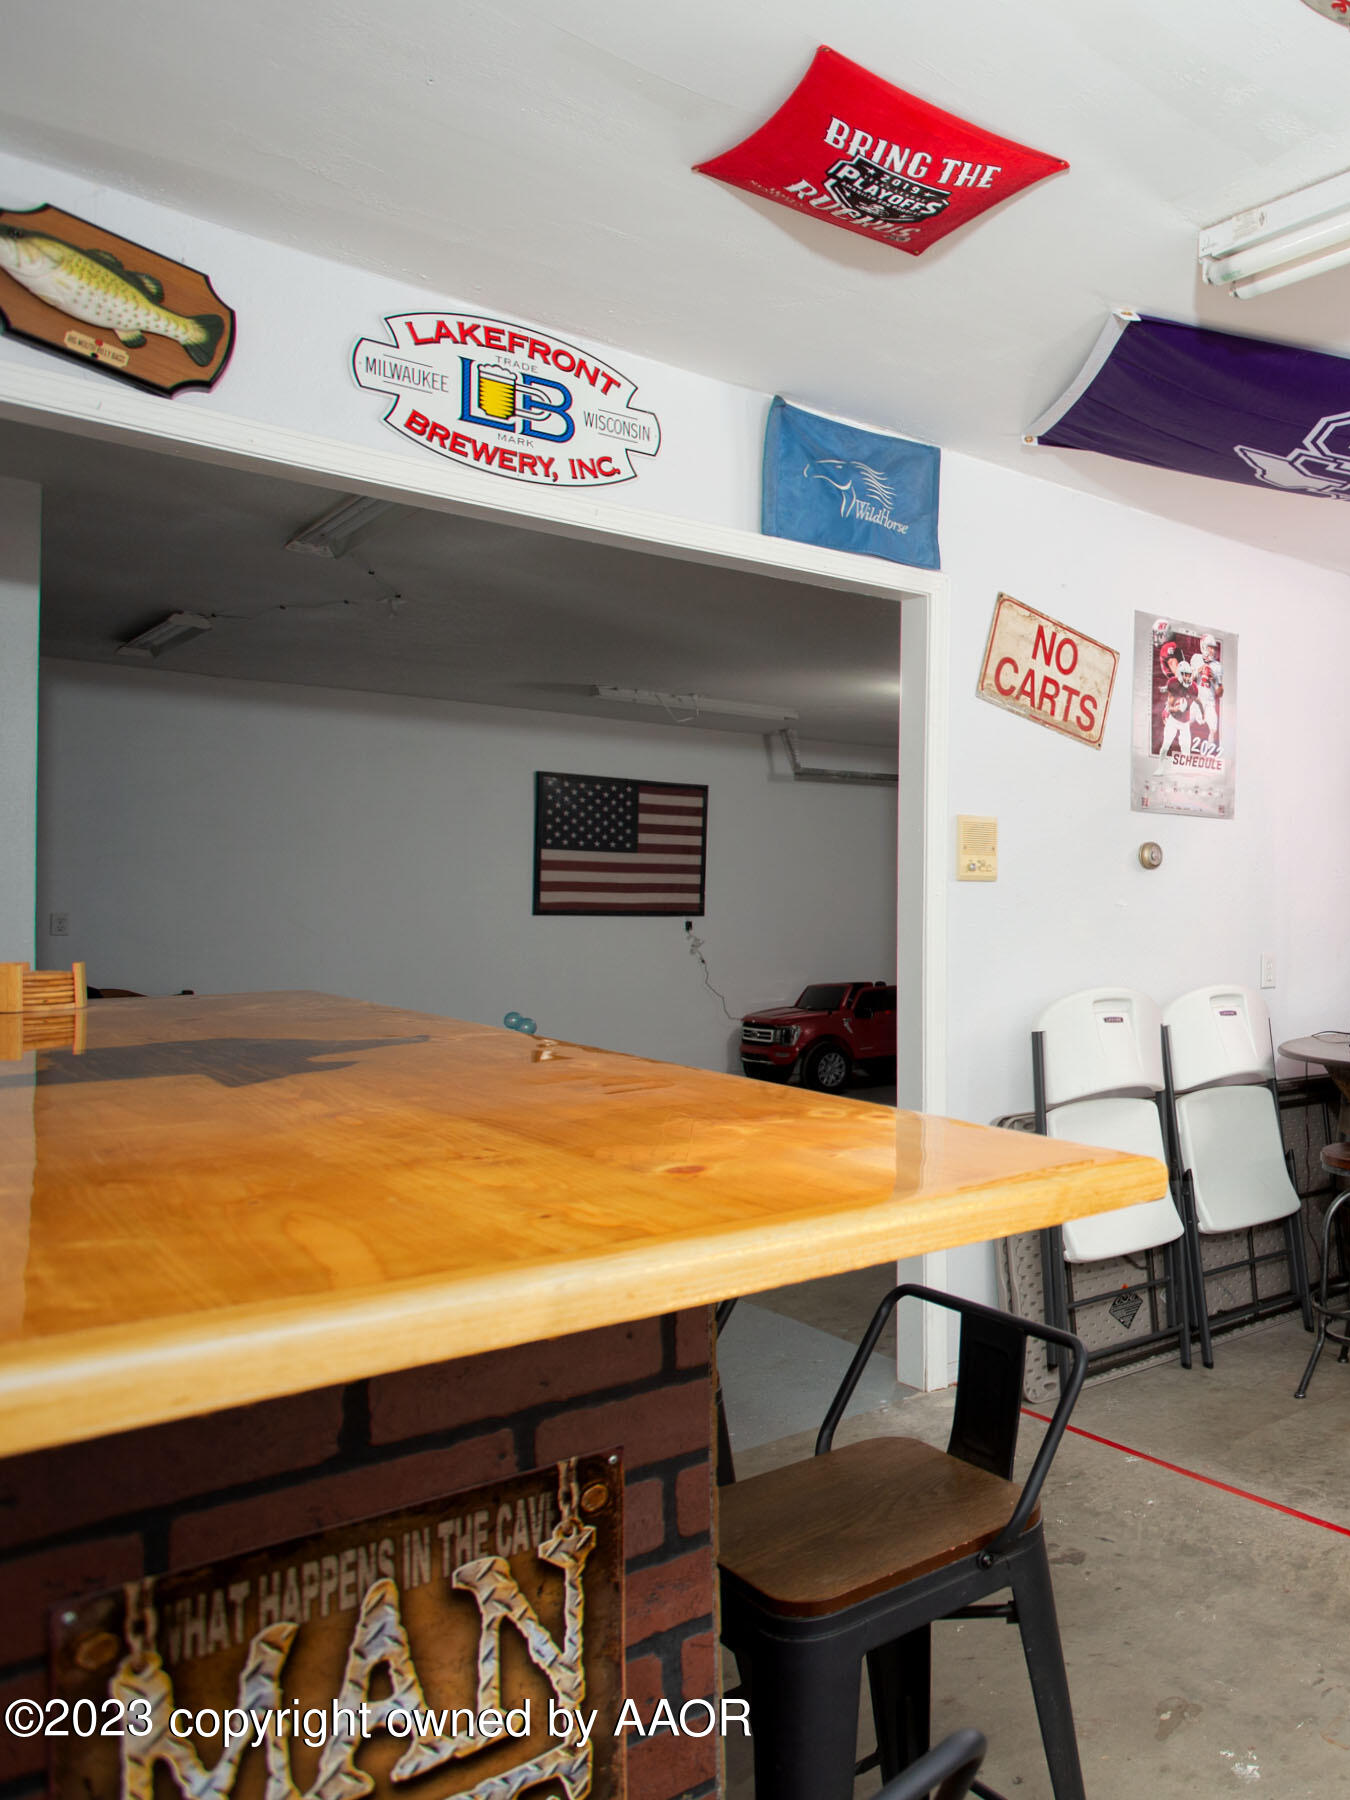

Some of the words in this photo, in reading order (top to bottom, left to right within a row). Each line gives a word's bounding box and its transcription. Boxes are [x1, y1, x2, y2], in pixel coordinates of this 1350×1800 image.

[823, 115, 933, 179] BRING
[936, 157, 1002, 190] THE
[836, 164, 943, 215] PLAYOFFS
[880, 173, 921, 195] 2019
[365, 356, 450, 393] MILWAUKEE
[405, 320, 622, 396] LAKEFRONT
[495, 354, 539, 375] TRADE
[404, 409, 559, 483] BREWERY,
[497, 432, 535, 449] MARK
[583, 410, 651, 442] WISCONSIN
[1031, 624, 1079, 676] NO
[994, 656, 1098, 733] CARTS
[1172, 753, 1223, 771] SCHEDULE
[164, 1579, 252, 1667] WHAT
[257, 1537, 397, 1632] HAPPENS
[402, 1527, 431, 1592] IN
[437, 1509, 491, 1580] THE
